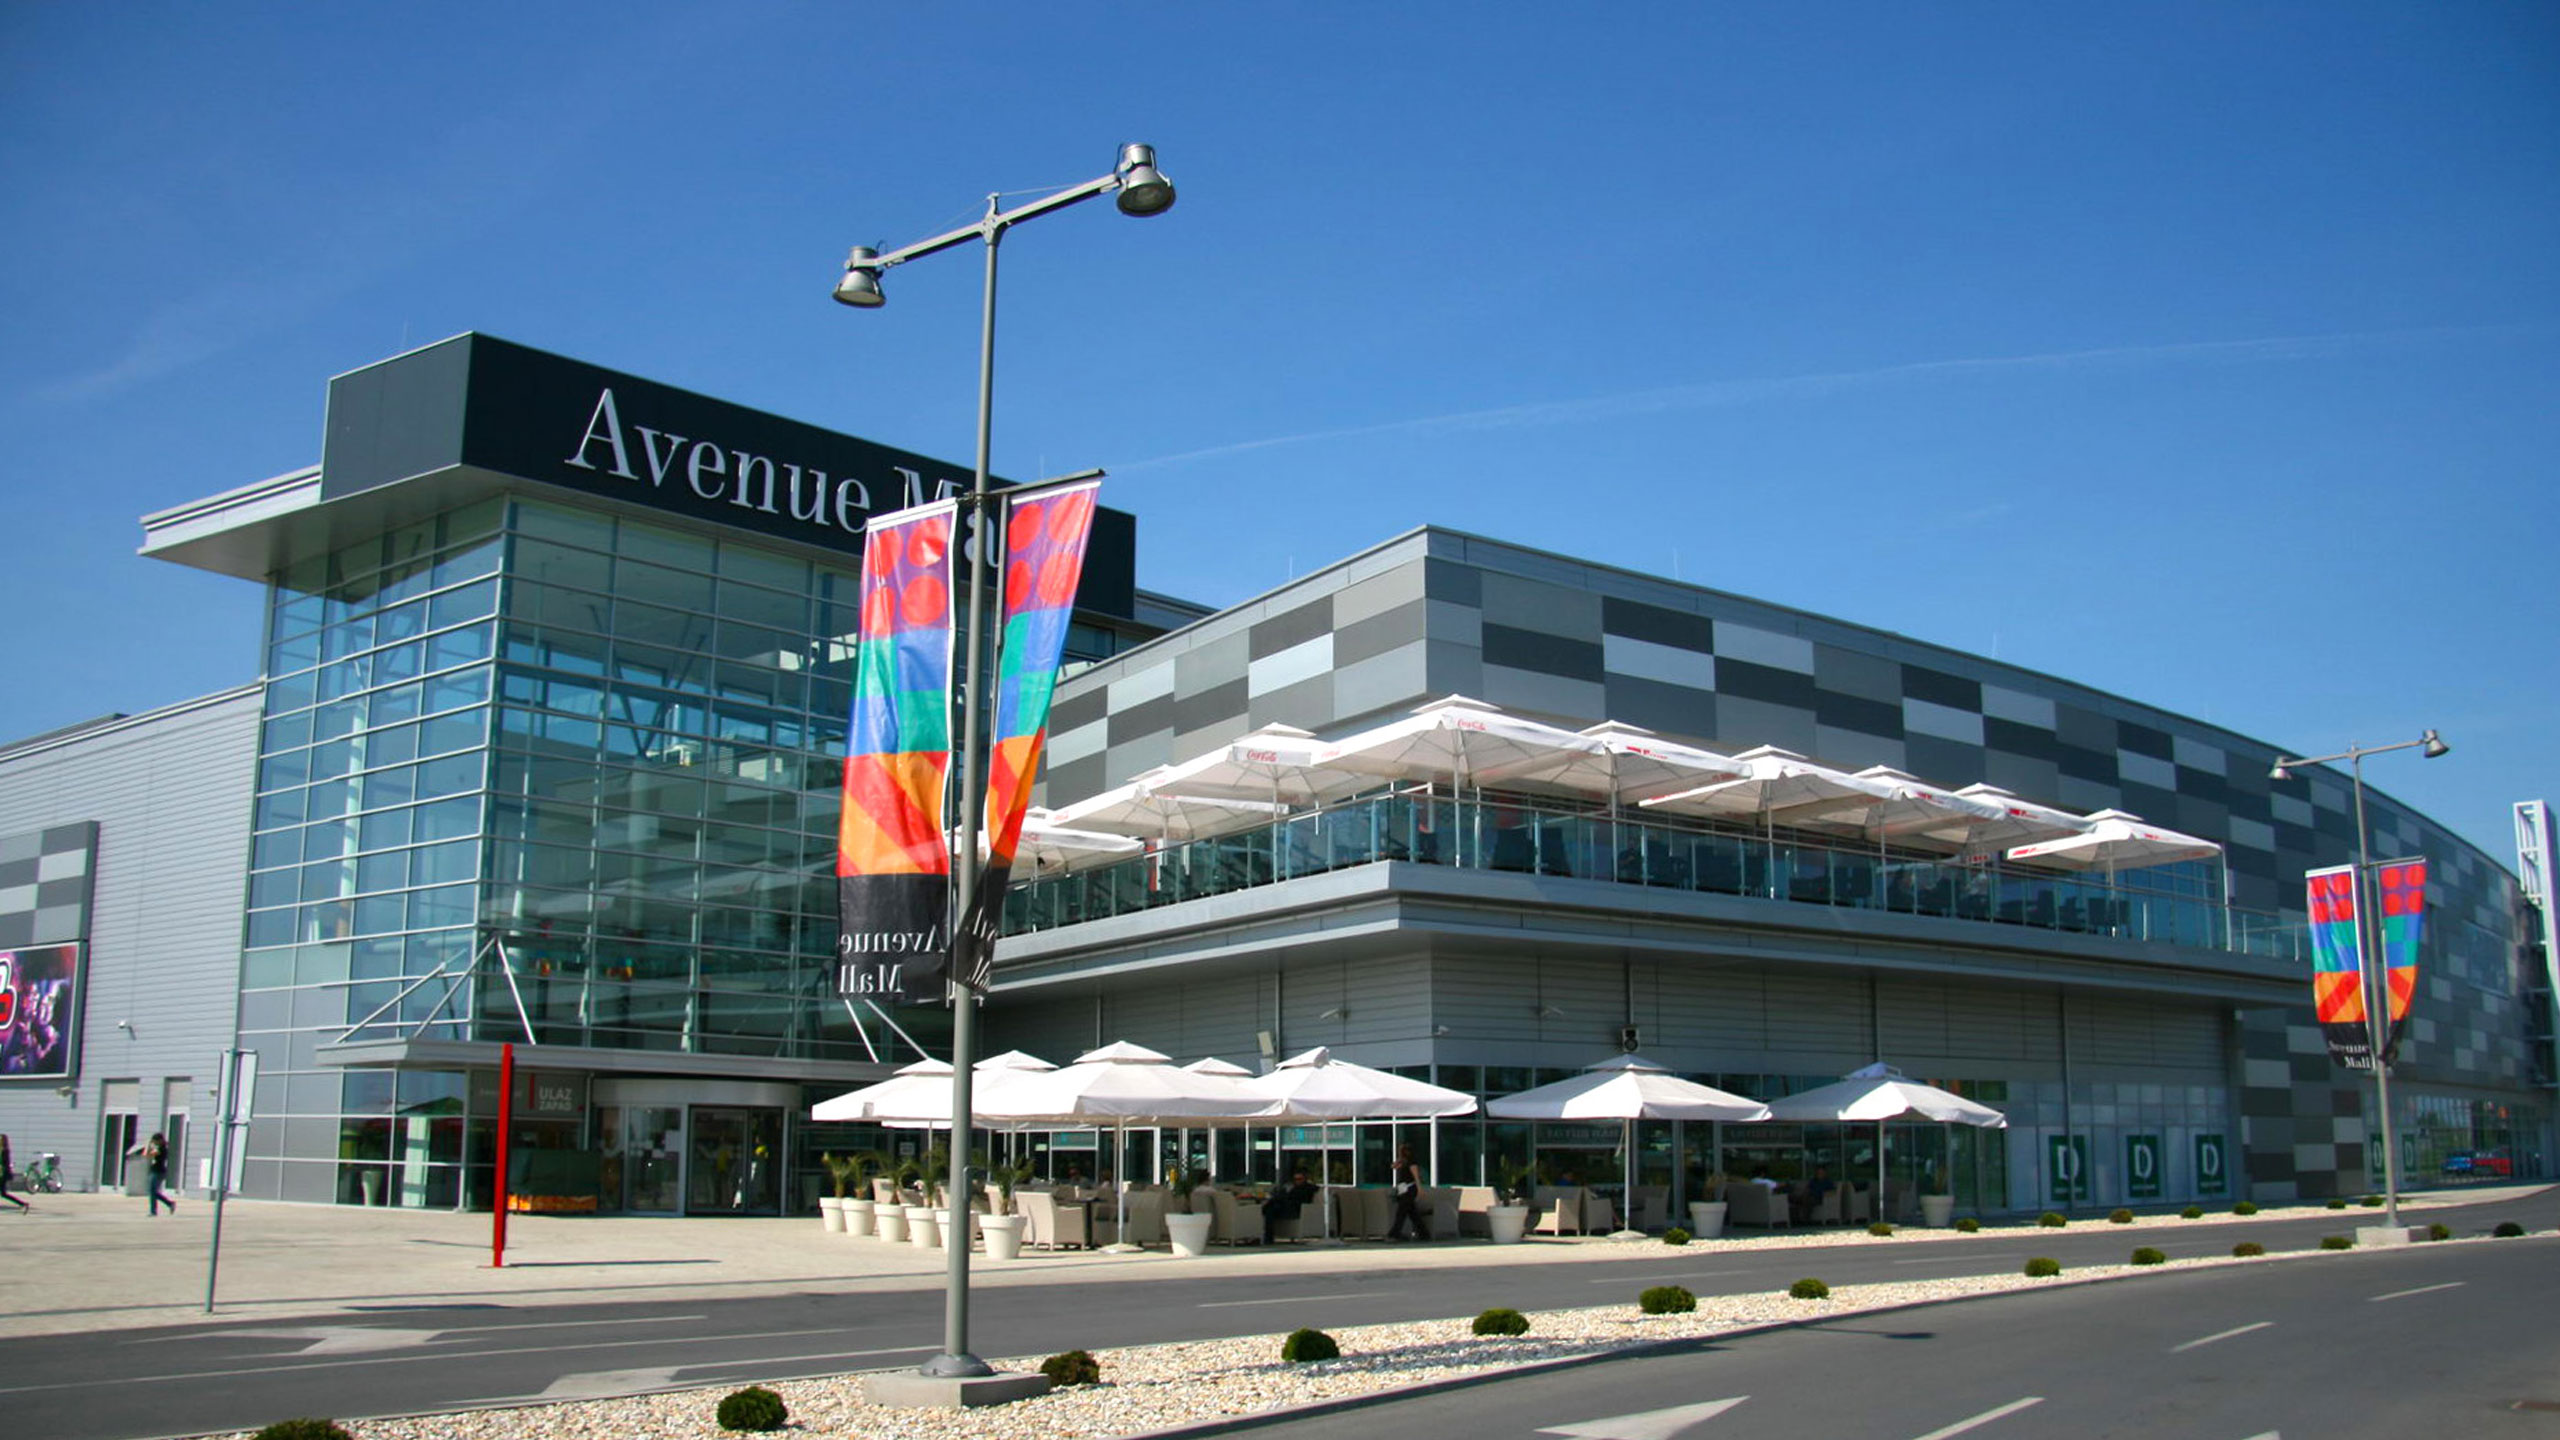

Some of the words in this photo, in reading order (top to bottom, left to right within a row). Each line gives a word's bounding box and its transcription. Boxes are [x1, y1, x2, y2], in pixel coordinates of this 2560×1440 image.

[564, 388, 870, 534] Avenue
[539, 1086, 573, 1101] ULAZ
[2133, 1144, 2153, 1178] D
[2201, 1143, 2219, 1176] D
